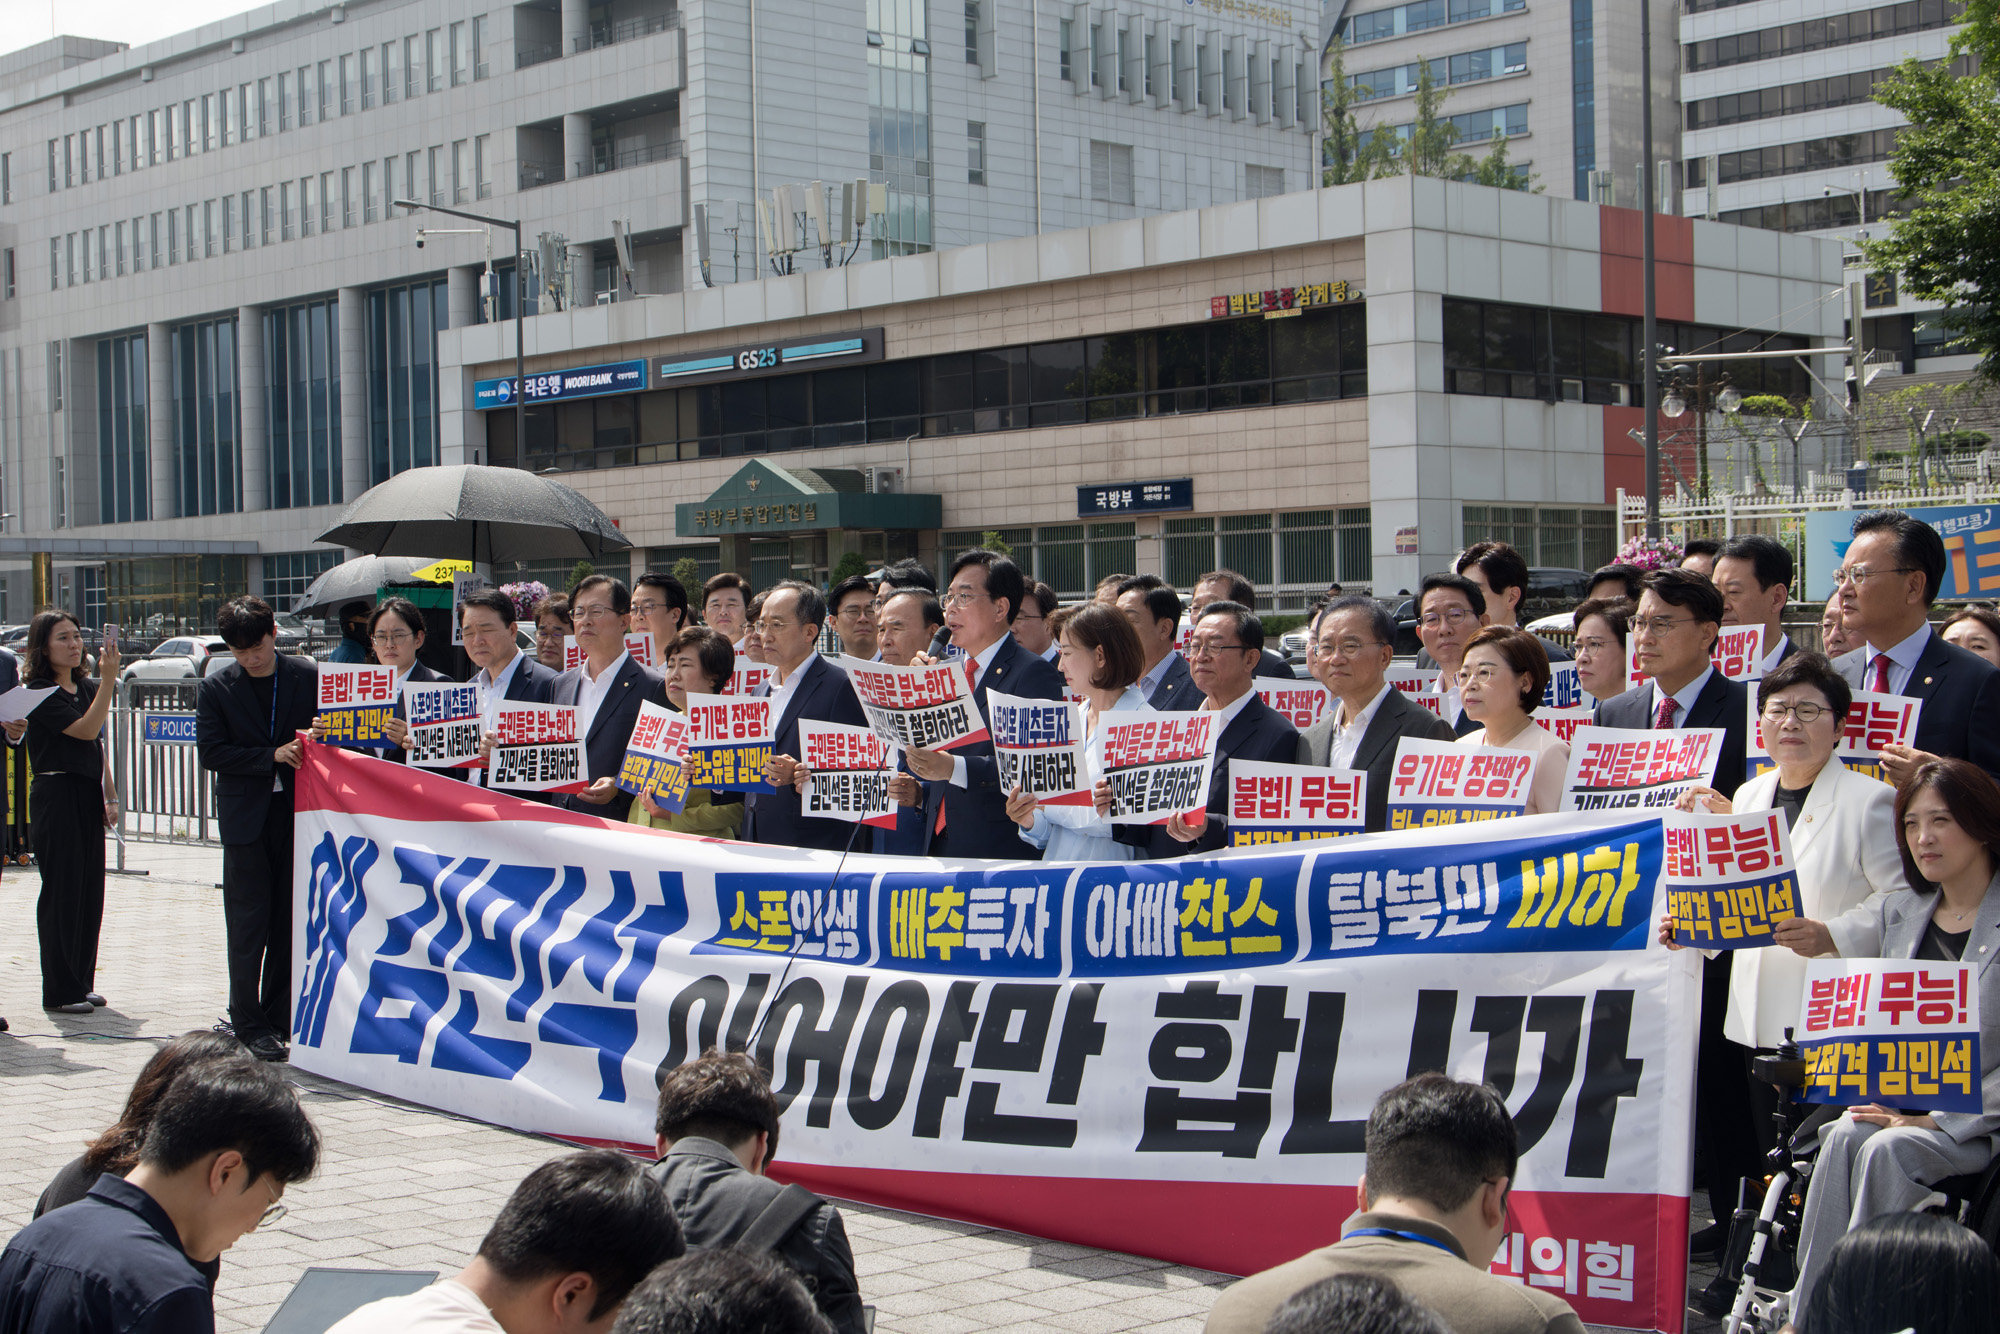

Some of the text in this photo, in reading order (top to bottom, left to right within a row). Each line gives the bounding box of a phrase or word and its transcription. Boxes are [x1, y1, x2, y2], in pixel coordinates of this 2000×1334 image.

[1230, 280, 1349, 314] 백년토종삼계탕
[738, 348, 776, 370] GS25
[565, 375, 590, 390] WOORI
[590, 373, 613, 386] BANK
[695, 502, 817, 528] 국방부종합민원실
[1096, 490, 1133, 509] 국방부
[321, 669, 394, 704] 불법! 무능!
[411, 686, 477, 724] 스폰의혹 배추투자
[853, 666, 957, 709] 국민들은 분노한다
[161, 721, 197, 737] POLICE
[497, 709, 576, 745] 국민들은 분노한다
[631, 713, 667, 750] 불법!
[690, 701, 770, 741] 우기면 장땡?
[908, 703, 970, 749] 철회하라
[1018, 705, 1071, 748] 배추투자
[412, 723, 481, 762] 김민석은 사퇴하라
[807, 732, 846, 770] 국민들은
[1104, 715, 1212, 769] 국민들은 분노한다
[1577, 740, 1652, 788] 국민들은
[1648, 732, 1714, 785] 분노한다
[495, 747, 580, 783] 김민석을 철회하라
[619, 754, 690, 803] 부적격 김민석
[690, 748, 735, 786] 분노유발
[1019, 751, 1077, 794] 사퇴하라
[1394, 754, 1531, 798] 우기면 장땡?
[809, 774, 850, 812] 김민석을
[1106, 764, 1205, 817] 김민석을 철회하라
[1234, 776, 1293, 819] 불법!
[1299, 775, 1362, 819] 무능!
[1666, 814, 1784, 877] 불법! 무능!
[714, 842, 1641, 961] 스폰인생 배추투자 아빠찬스 탈북민 비하
[1668, 878, 1797, 941] 부적격 김민석
[292, 830, 380, 1049] 왜
[1135, 980, 1644, 1179] 합니까
[1806, 969, 1969, 1032] 불법! 무능!
[1802, 1039, 1972, 1099] 부적격 김민석
